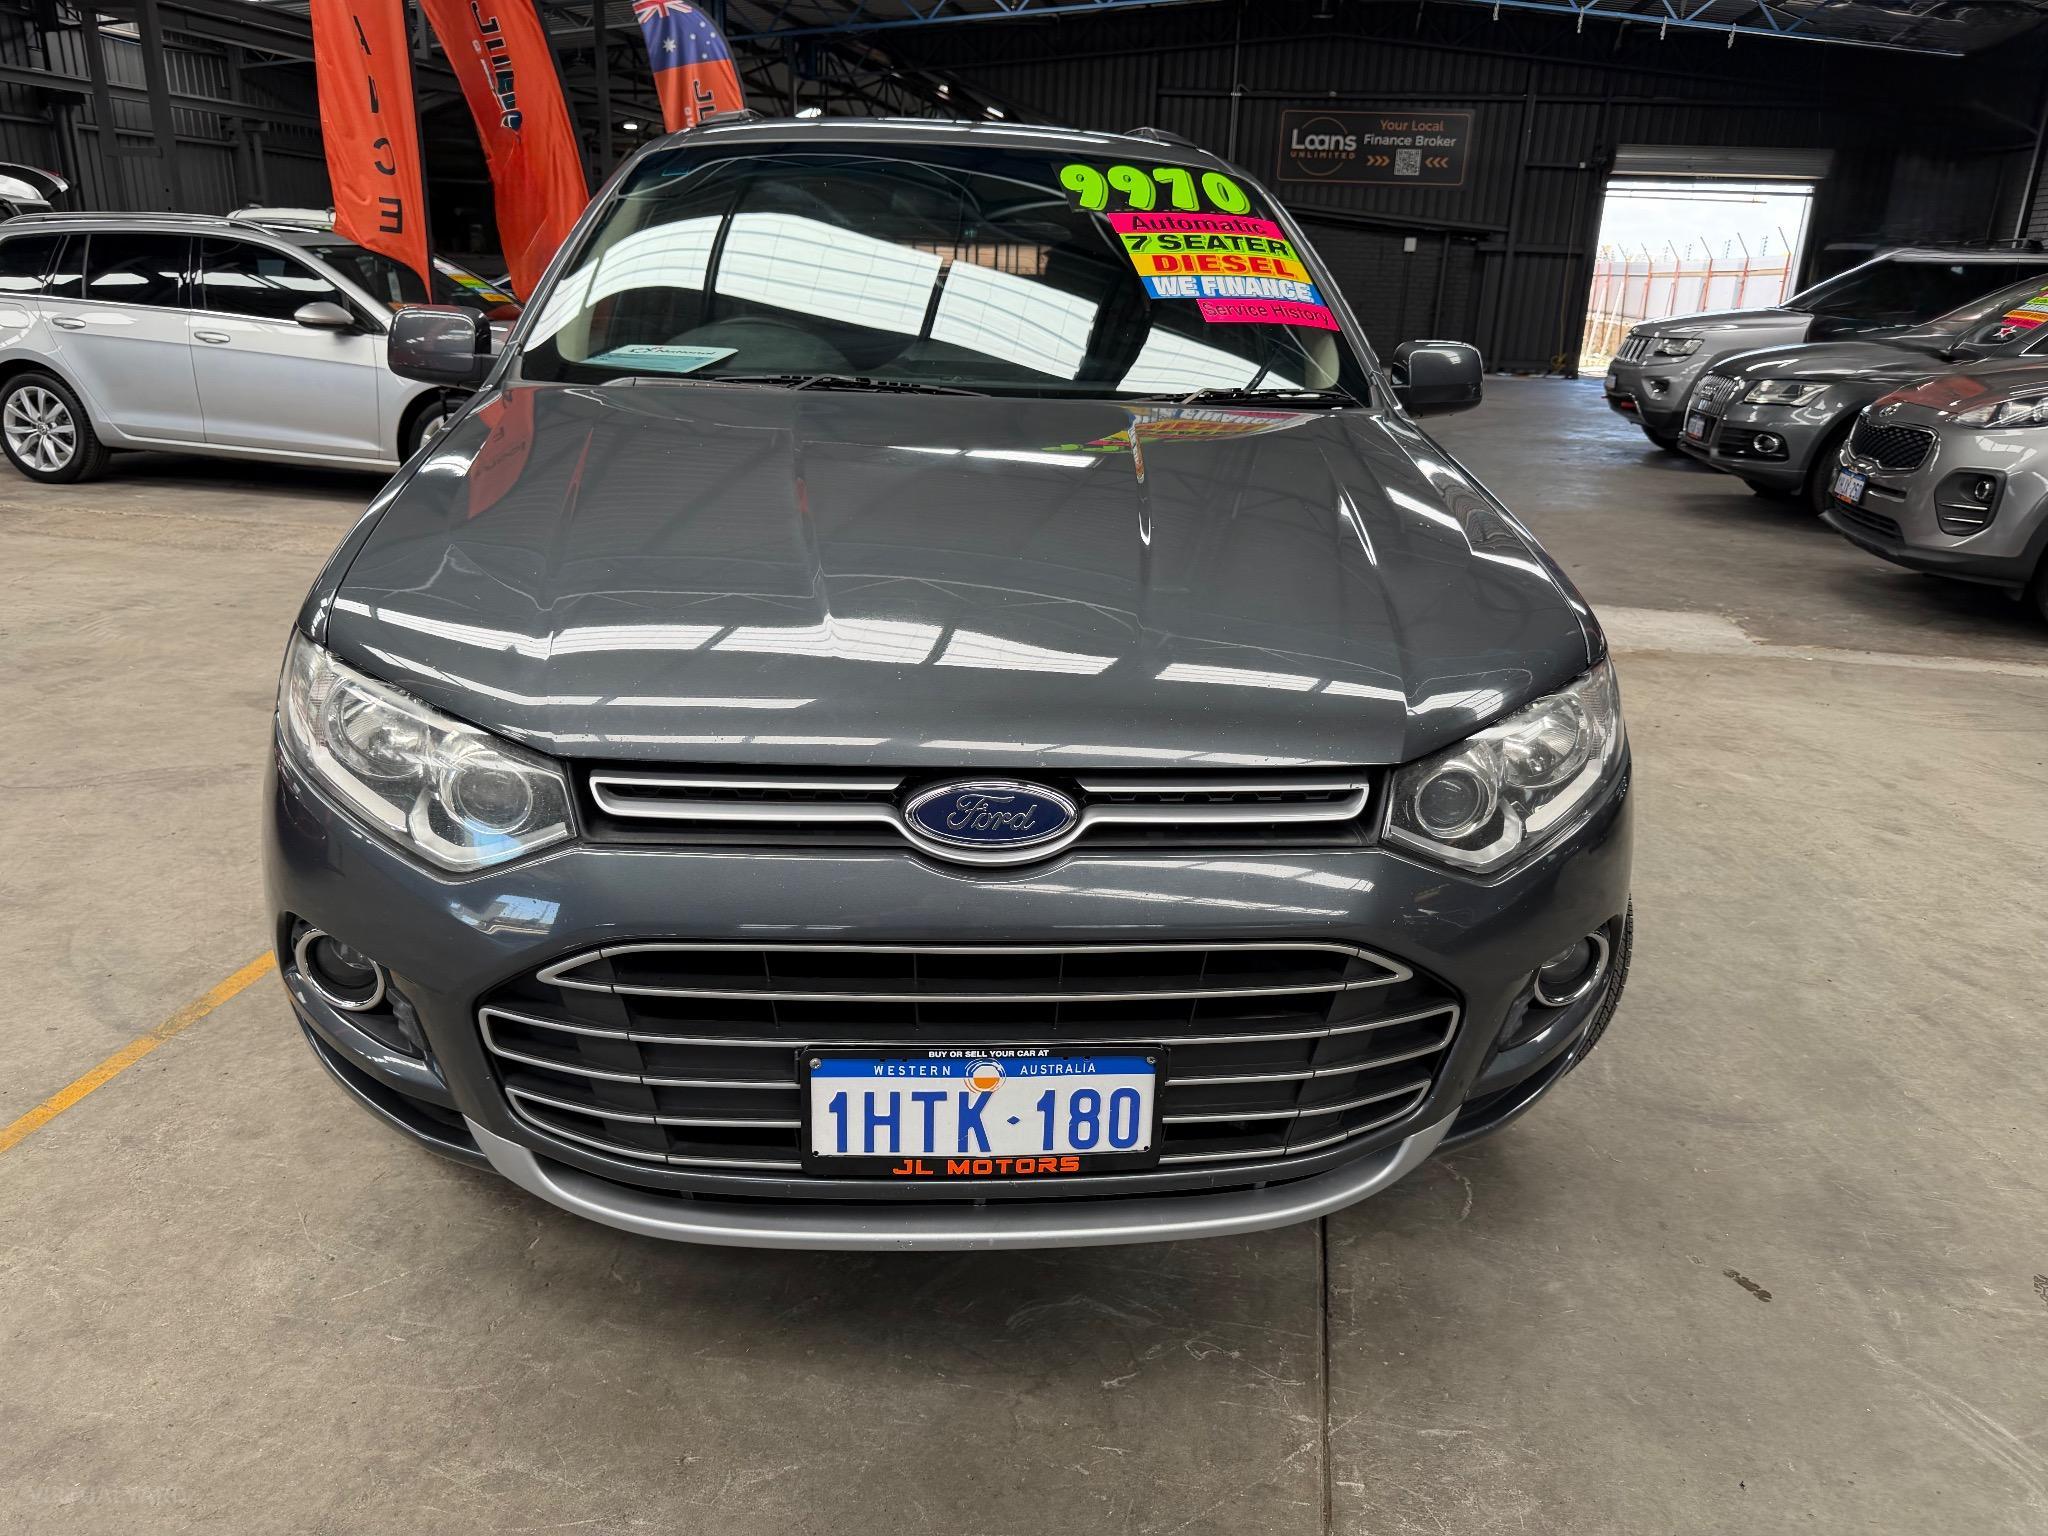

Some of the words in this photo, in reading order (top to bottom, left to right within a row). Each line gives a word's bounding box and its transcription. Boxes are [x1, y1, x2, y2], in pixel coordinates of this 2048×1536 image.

[1380, 119, 1408, 131] Your
[1411, 120, 1445, 132] Local
[1291, 128, 1357, 151] Loans
[1363, 134, 1412, 147] Finance
[1415, 135, 1457, 148] Broker
[1290, 151, 1357, 160] UNLIMITED
[1060, 164, 1251, 215] 9970
[1131, 215, 1268, 236] Automatic
[1129, 235, 1148, 252] 7
[1158, 234, 1291, 258] SEATER
[1152, 255, 1299, 279] DIESEL
[1151, 276, 1200, 298] WE
[1202, 276, 1316, 304] FINANCE
[1202, 301, 1268, 318] Service
[1271, 304, 1329, 326] History
[947, 793, 1038, 830] Ford
[928, 1050, 948, 1058] BUY
[949, 1050, 963, 1058] OR
[964, 1050, 988, 1058] SELL
[989, 1050, 1015, 1058] YOUR
[1016, 1049, 1036, 1057] CAR
[1037, 1049, 1050, 1057] AT
[873, 1065, 951, 1076] WESTERN
[1020, 1063, 1096, 1075] AUSTRALIA
[892, 1159, 934, 1175] JL
[947, 1156, 1080, 1175] MOTORS
